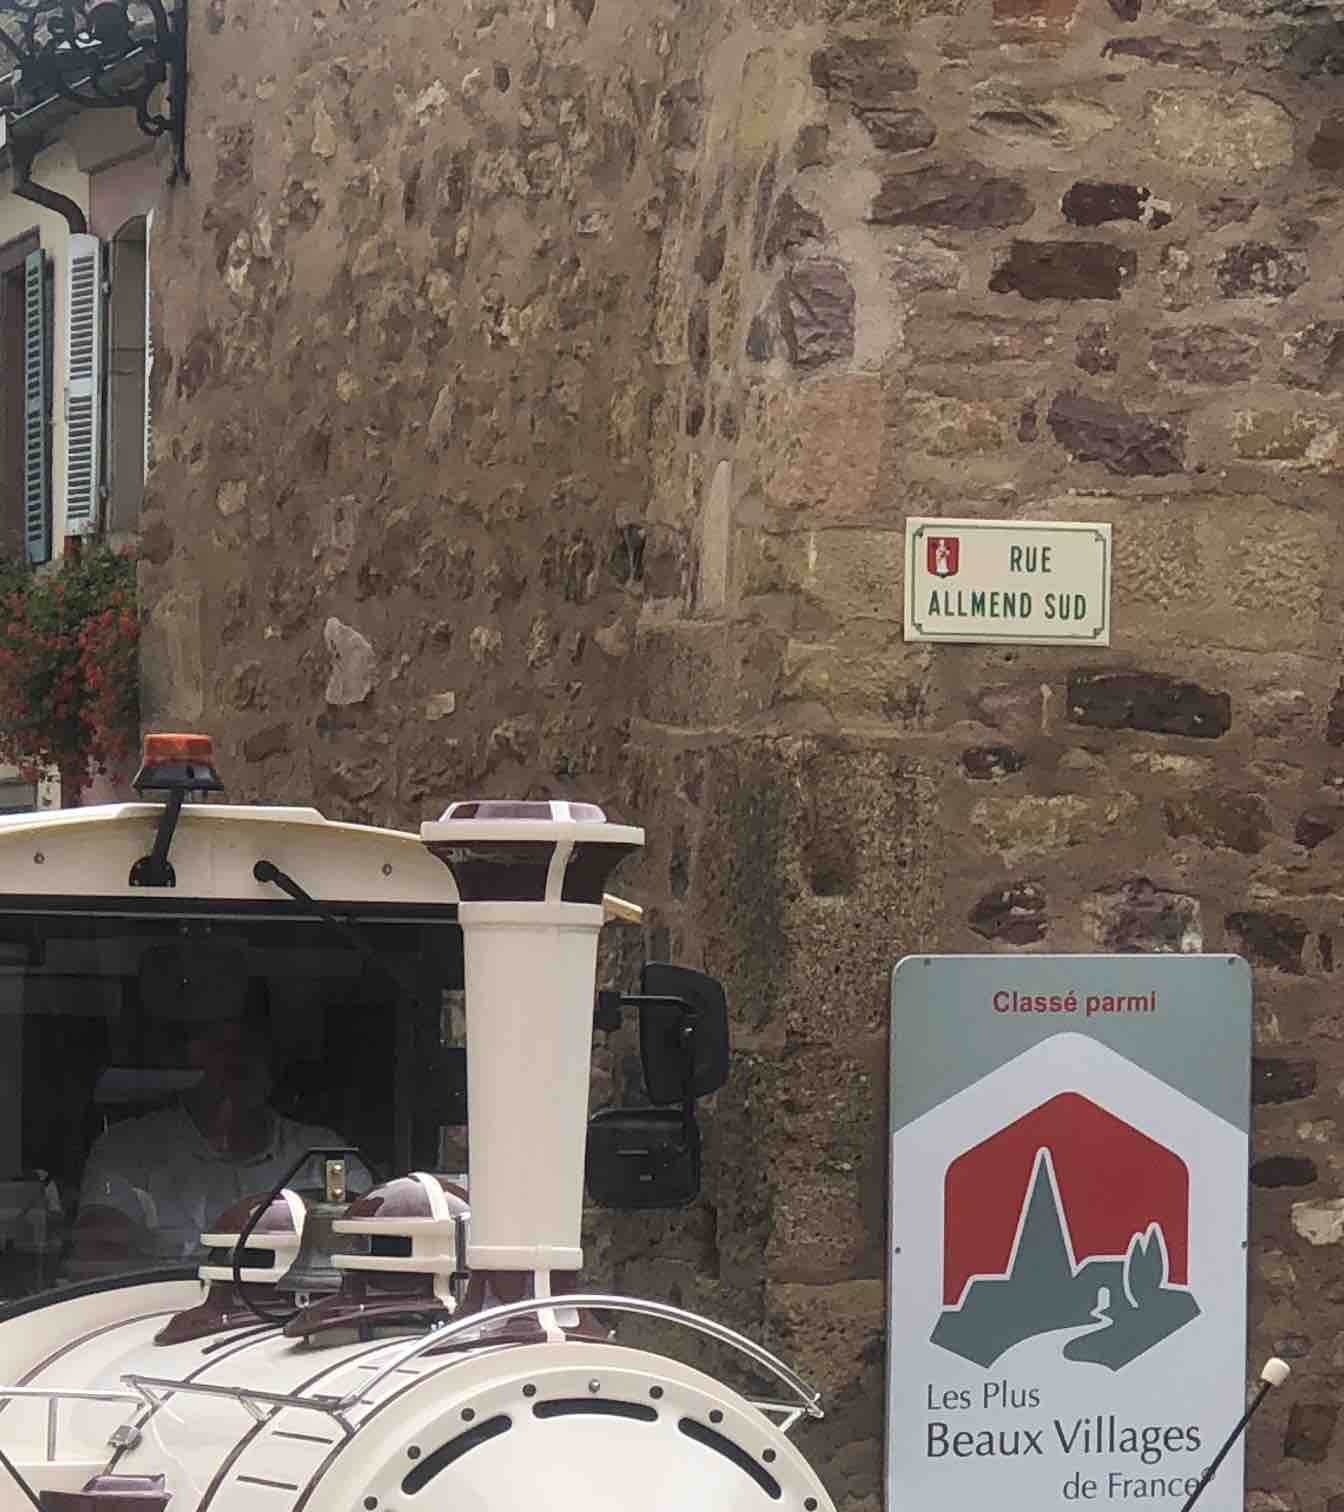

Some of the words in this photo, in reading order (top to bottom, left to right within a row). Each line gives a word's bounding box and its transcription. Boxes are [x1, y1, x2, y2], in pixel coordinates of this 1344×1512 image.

[1009, 545, 1052, 573] RUE
[927, 590, 1032, 619] ALLMEND
[1044, 592, 1087, 621] SUD
[992, 990, 1078, 1013] Classé
[1085, 990, 1158, 1016] parmi
[927, 1383, 971, 1411] Les
[983, 1379, 1041, 1408] Plus
[926, 1421, 1044, 1458] Beaux
[1053, 1415, 1202, 1465] Villages
[1062, 1471, 1097, 1499] de
[1107, 1471, 1201, 1499] France
